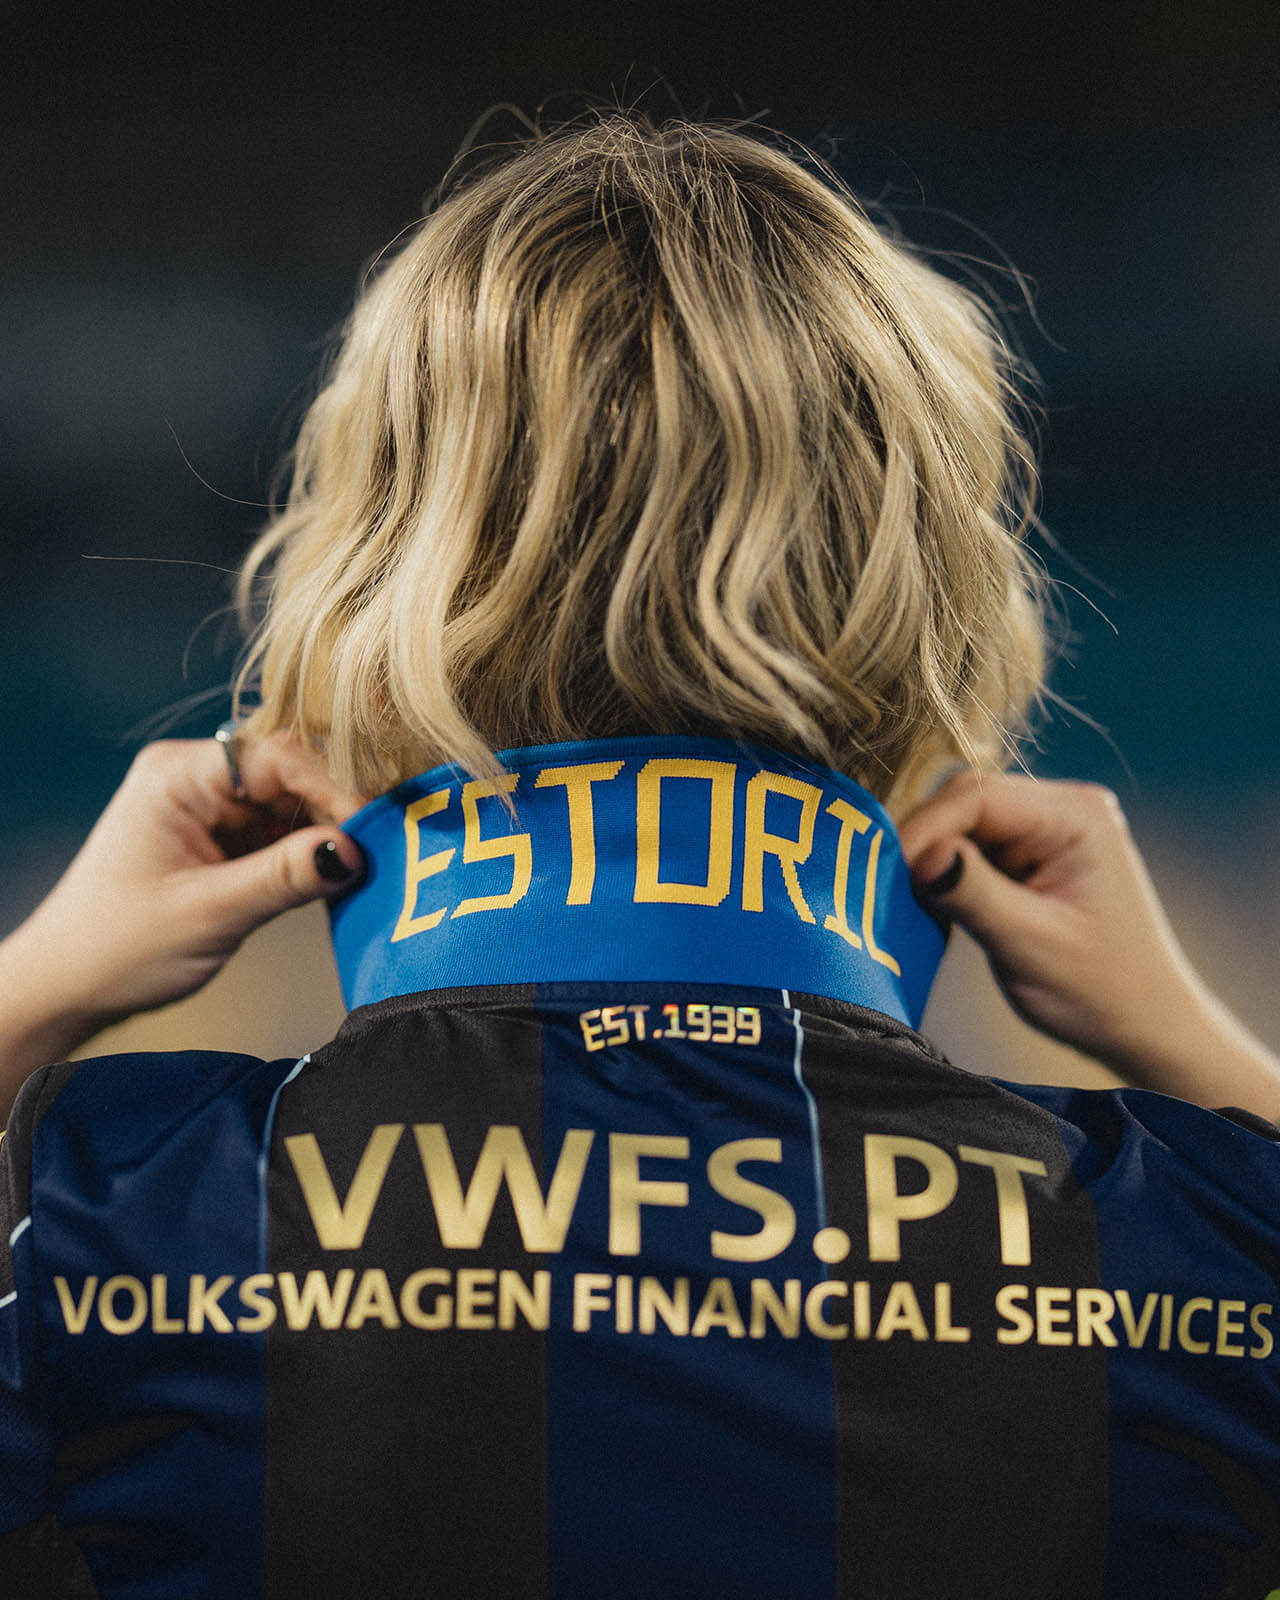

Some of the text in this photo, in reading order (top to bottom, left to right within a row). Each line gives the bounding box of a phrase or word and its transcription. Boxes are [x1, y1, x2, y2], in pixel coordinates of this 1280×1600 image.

[390, 758, 902, 977] ESTORIL
[579, 1003, 762, 1052] EST.1939
[285, 1123, 1048, 1266] VWFS.PT
[53, 1268, 1275, 1360] VOLKSWAGEN FINANCIAL SERVICES
